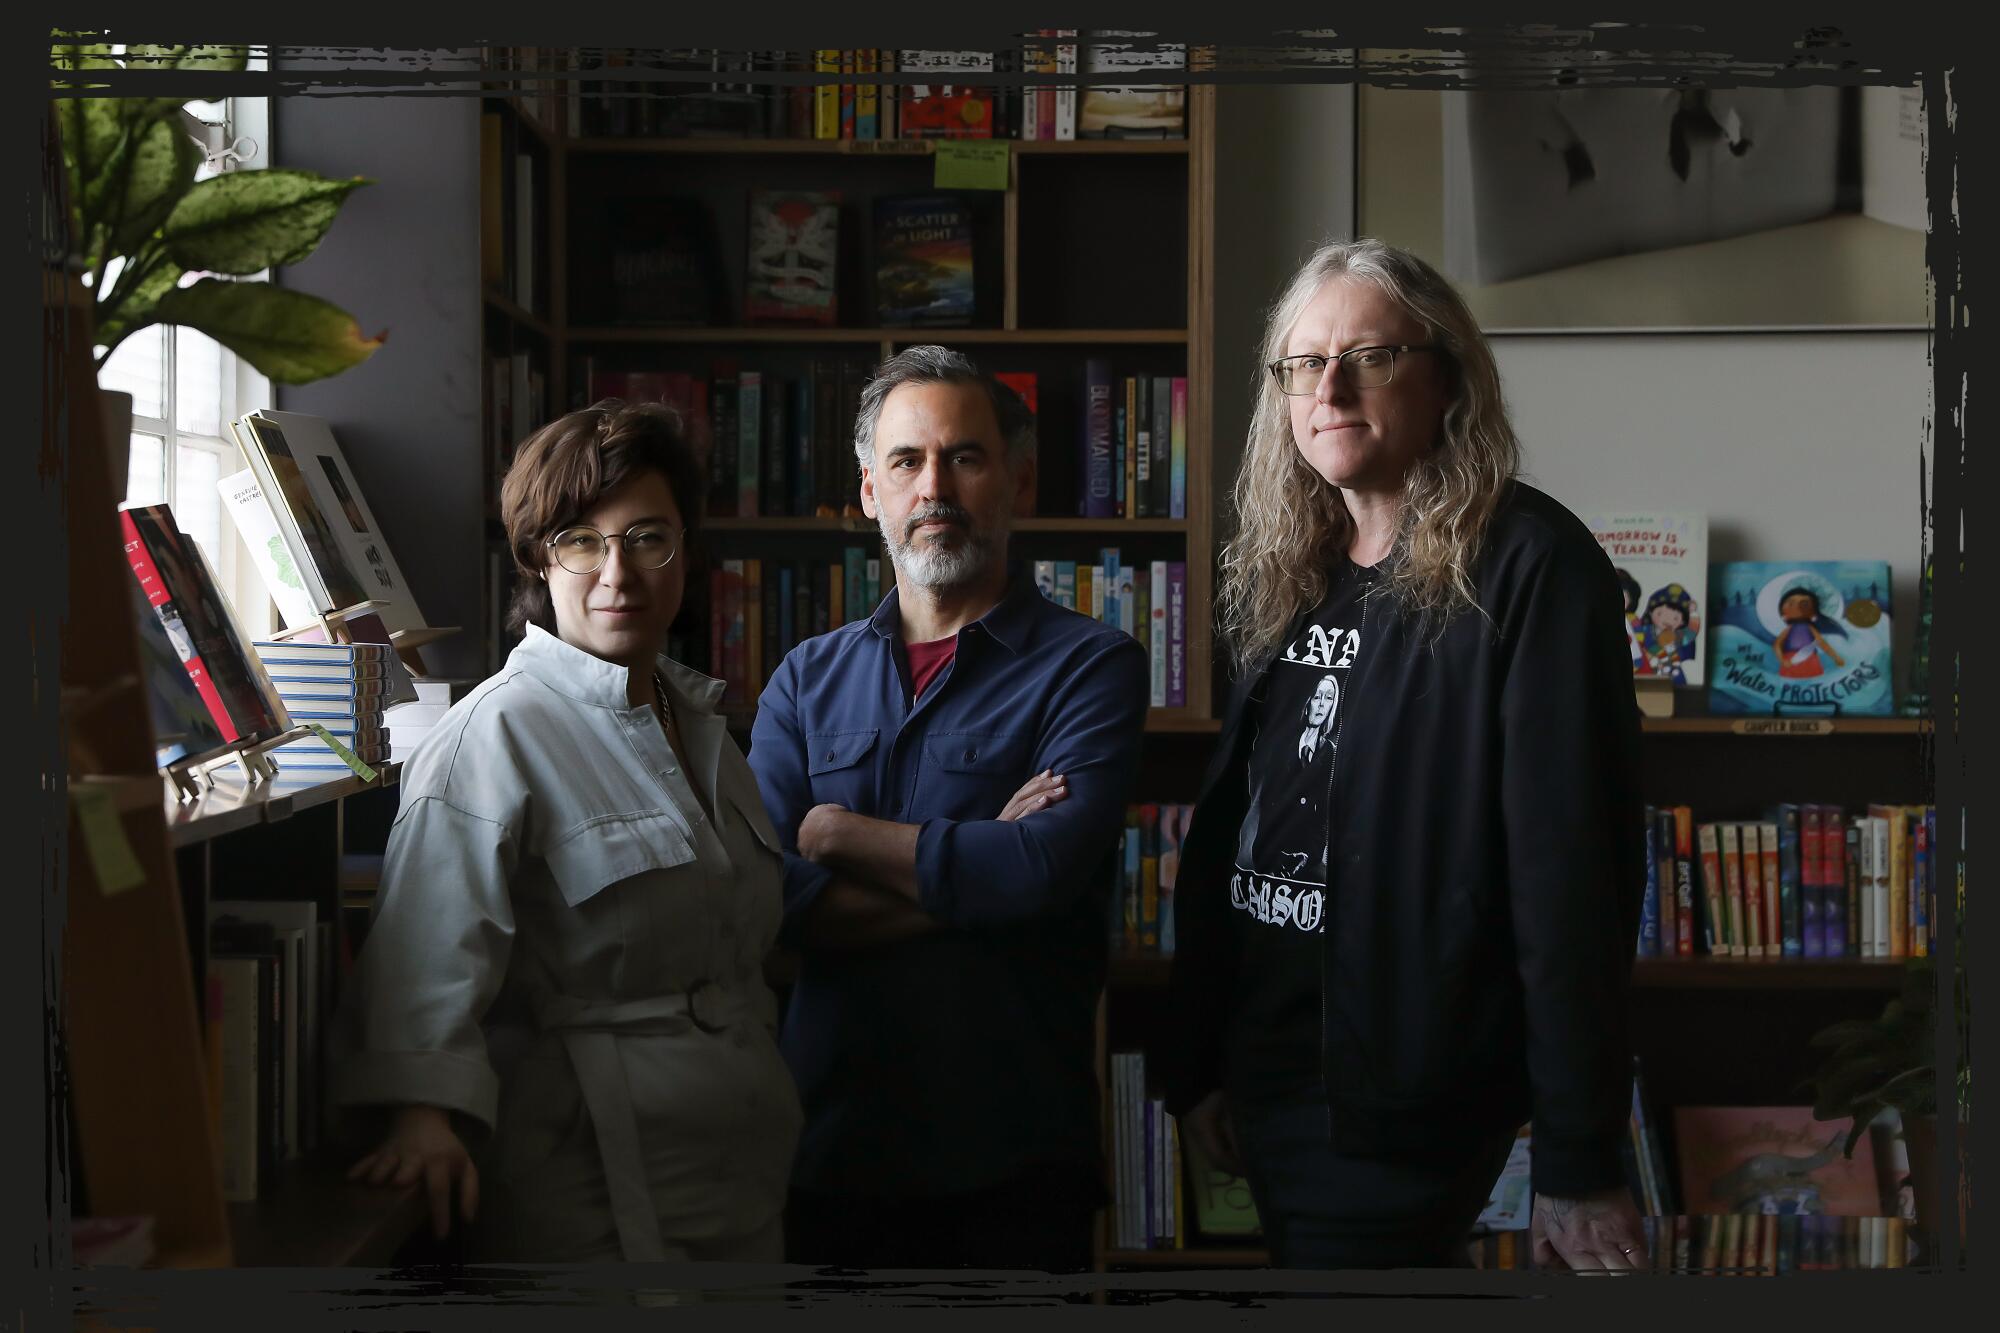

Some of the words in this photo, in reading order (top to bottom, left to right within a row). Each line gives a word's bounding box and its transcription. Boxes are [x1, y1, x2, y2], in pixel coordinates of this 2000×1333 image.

[896, 213, 959, 228] SCATTER
[910, 228, 952, 242] LIGHT
[1613, 544, 1656, 555] YEAR'S
[1662, 545, 1687, 558] DAY
[1666, 532, 1677, 543] IS
[1172, 582, 1182, 640] THREE
[1287, 624, 1361, 667] NA
[1172, 643, 1182, 690] KEYS
[1723, 657, 1776, 697] Water
[1780, 660, 1881, 703] PROTECTORS
[1744, 720, 1786, 733] CHAPTER
[1790, 720, 1820, 733] BOOKS
[1231, 872, 1326, 934] CARSO
